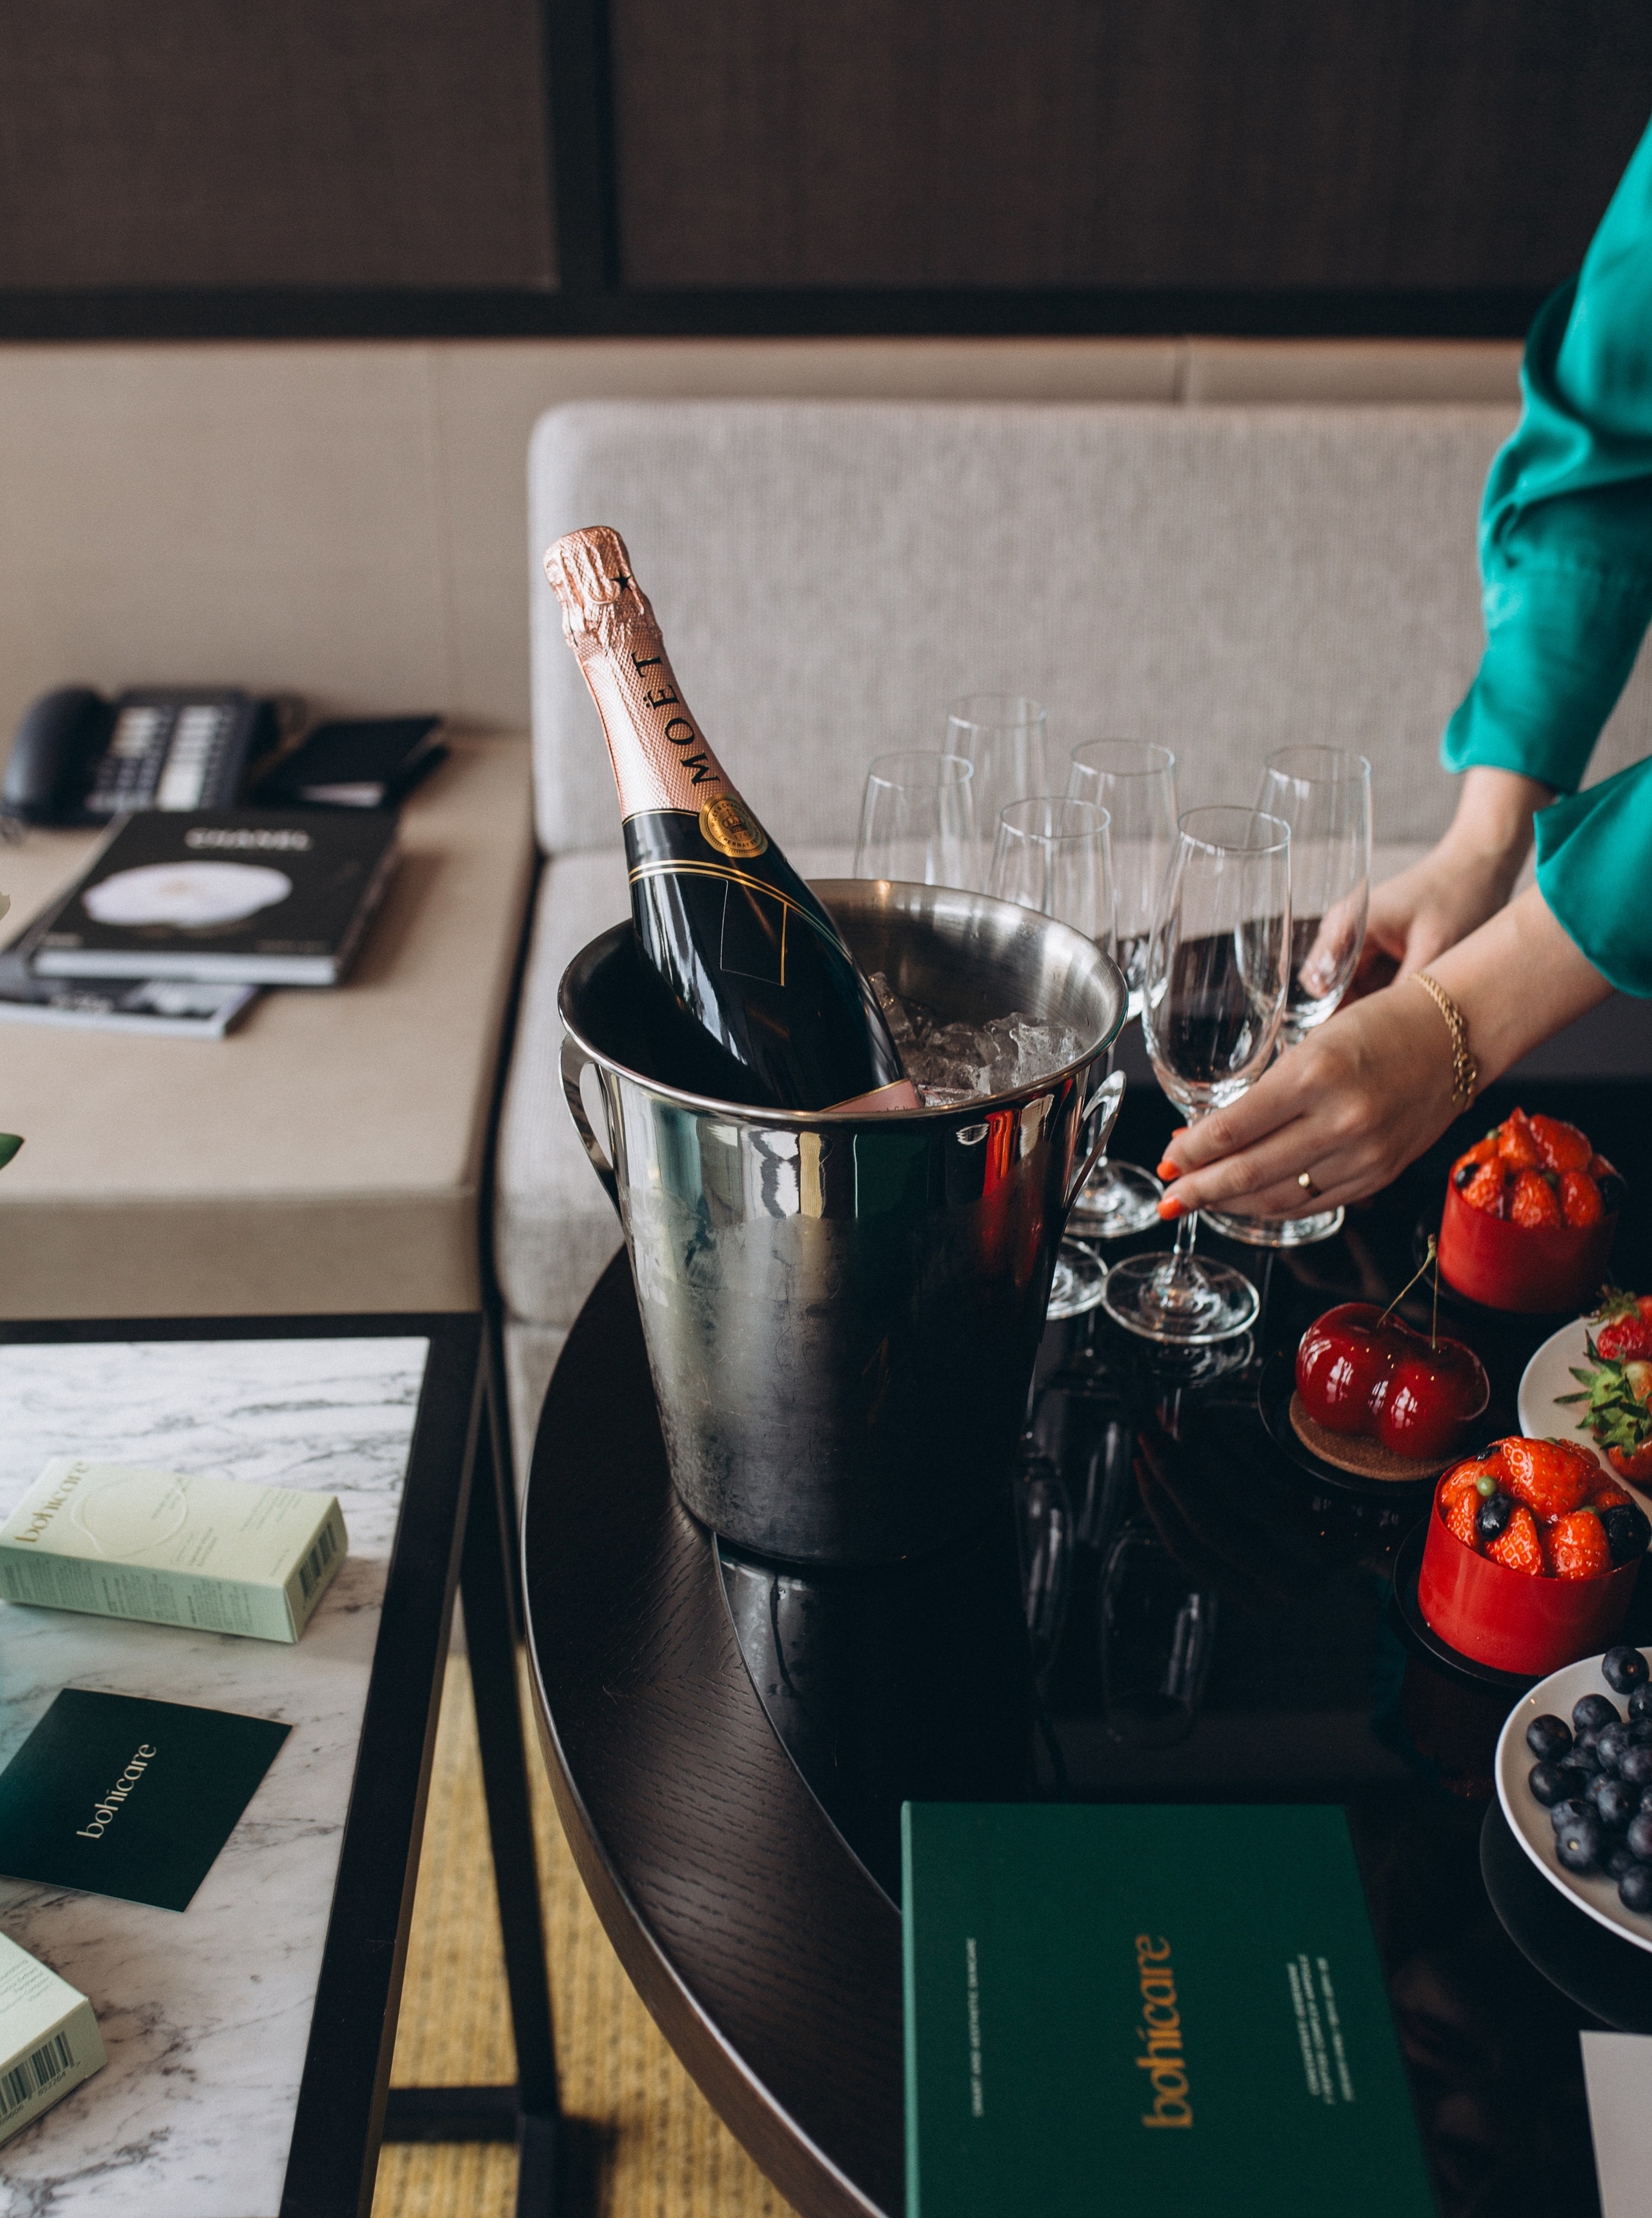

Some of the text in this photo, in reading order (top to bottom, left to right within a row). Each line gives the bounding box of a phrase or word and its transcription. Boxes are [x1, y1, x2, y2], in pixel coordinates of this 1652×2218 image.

[631, 652, 721, 787] MOËT
[14, 1461, 90, 1542] bohicare
[76, 1744, 157, 1839] bohicare
[1135, 1934, 1193, 2127] bohicare
